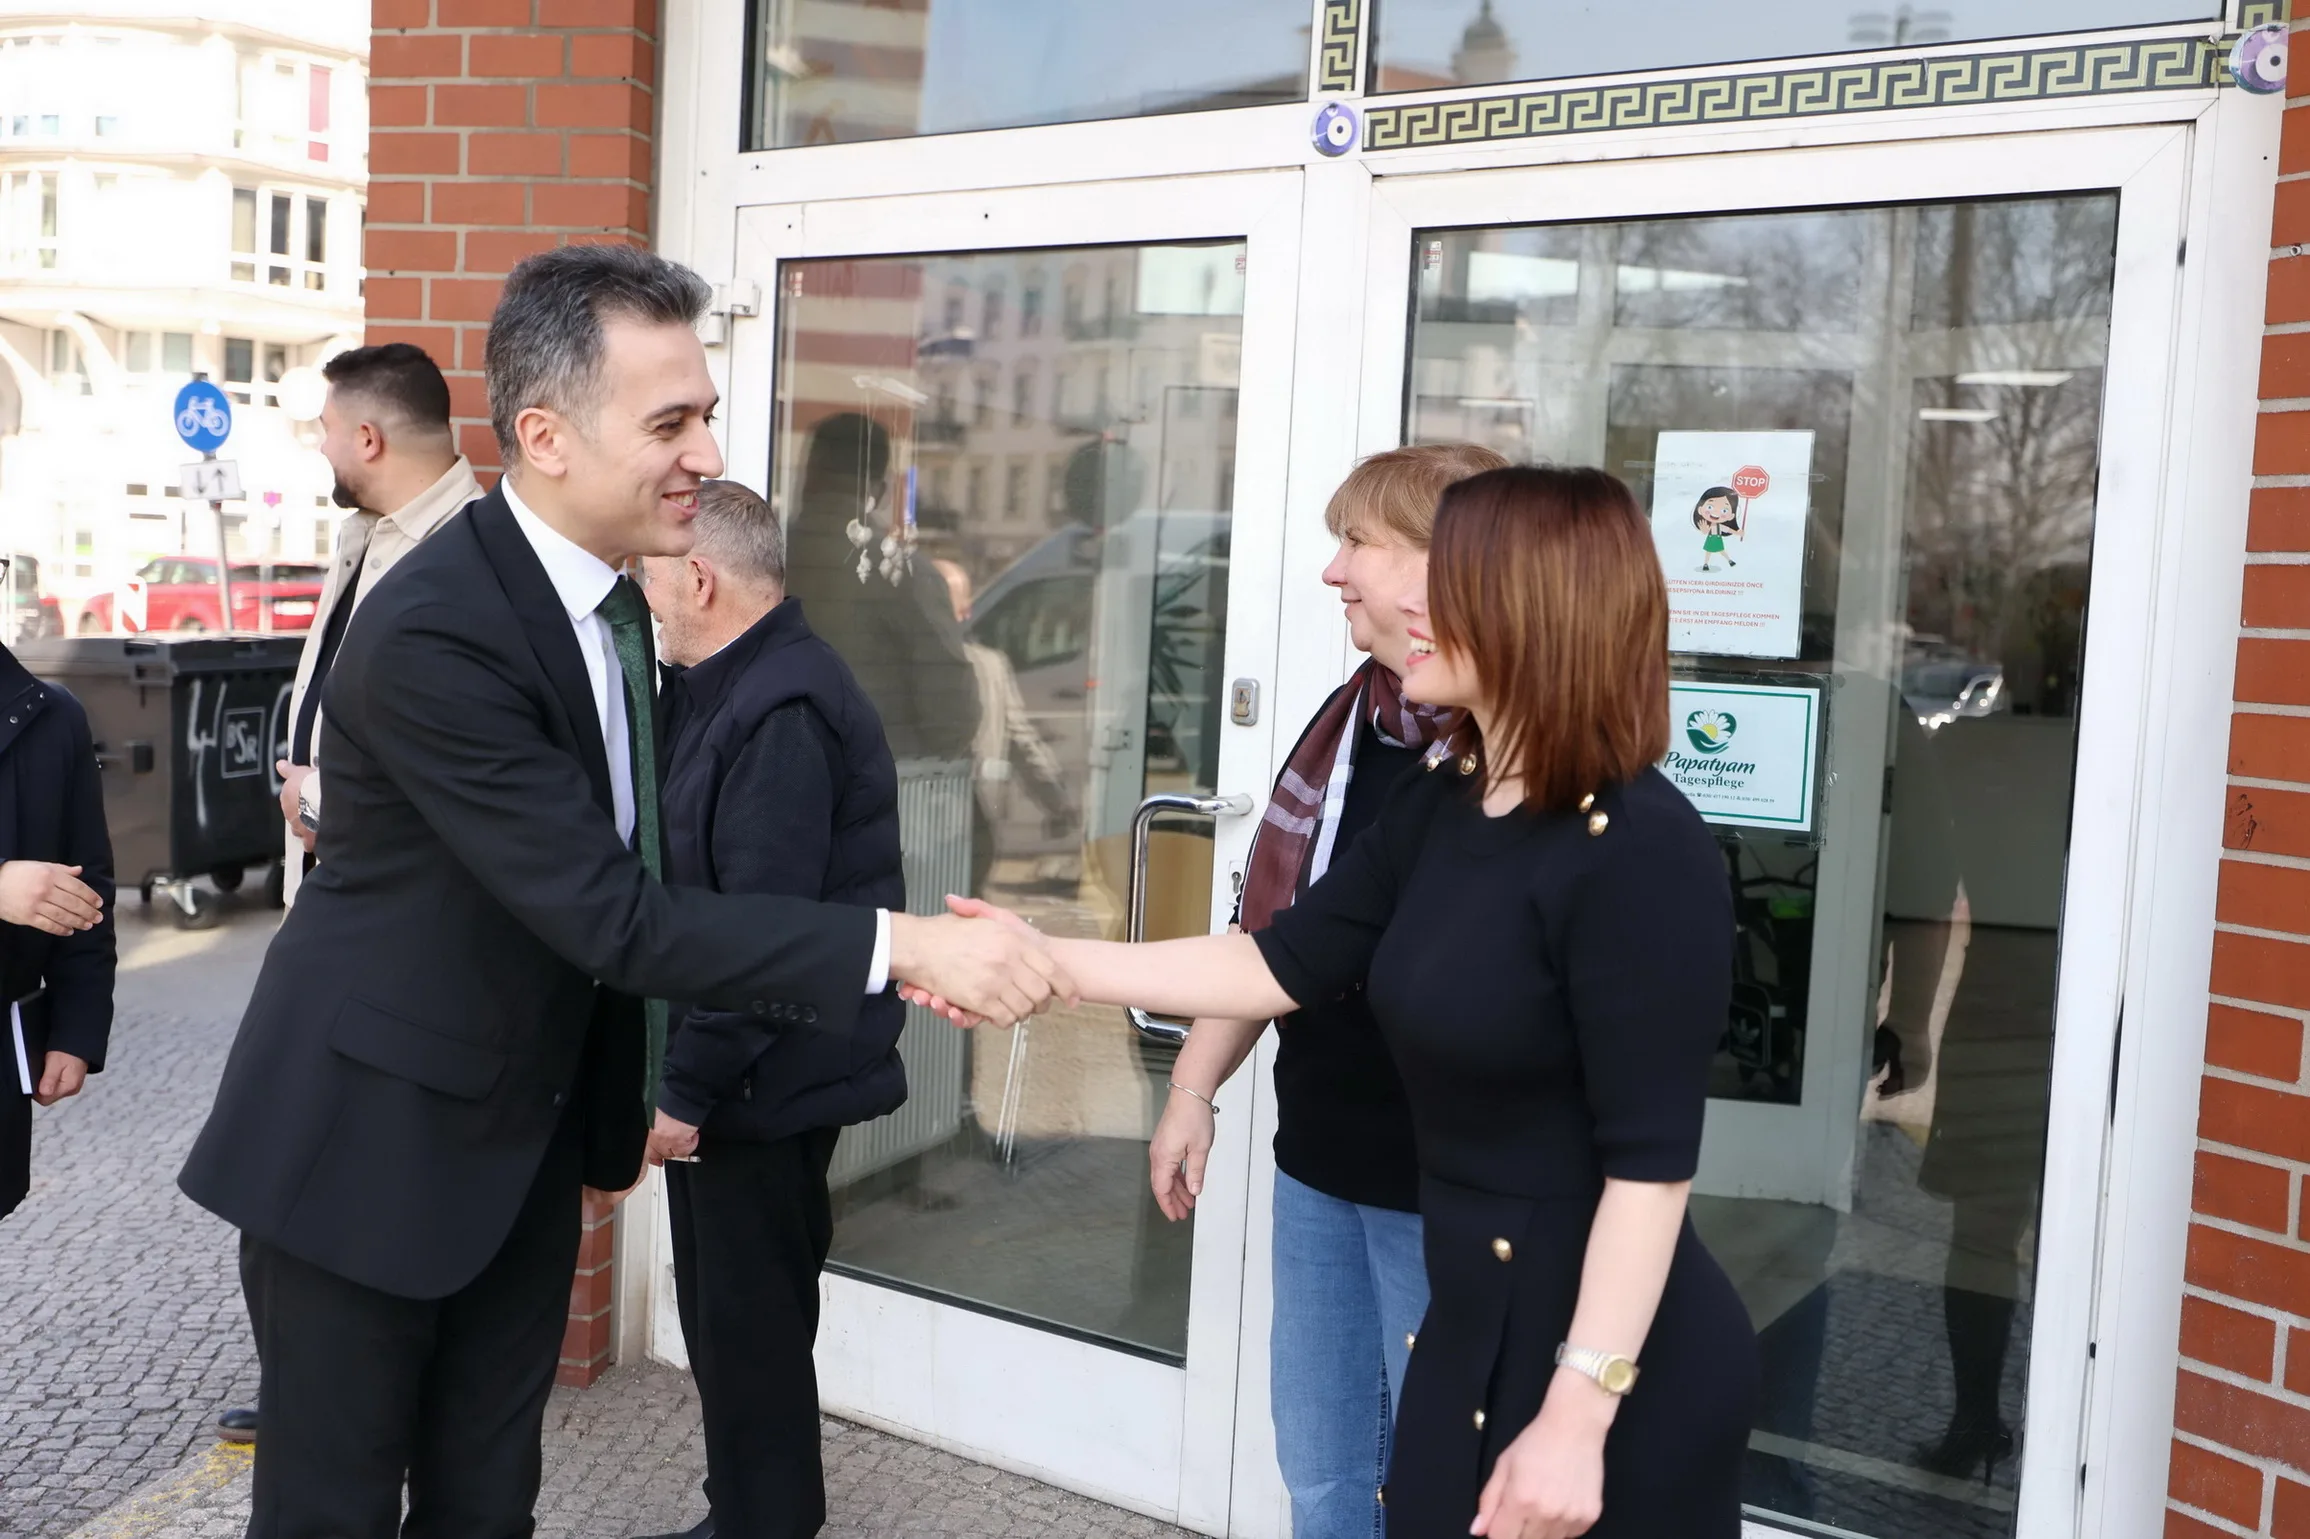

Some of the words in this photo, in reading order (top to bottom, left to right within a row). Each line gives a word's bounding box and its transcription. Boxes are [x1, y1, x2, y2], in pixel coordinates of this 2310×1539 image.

[1736, 476, 1765, 487] STOP
[1711, 611, 1752, 619] TAGESPFLEGE
[1664, 751, 1756, 777] Papatyam
[1673, 773, 1745, 790] Tagespflege
